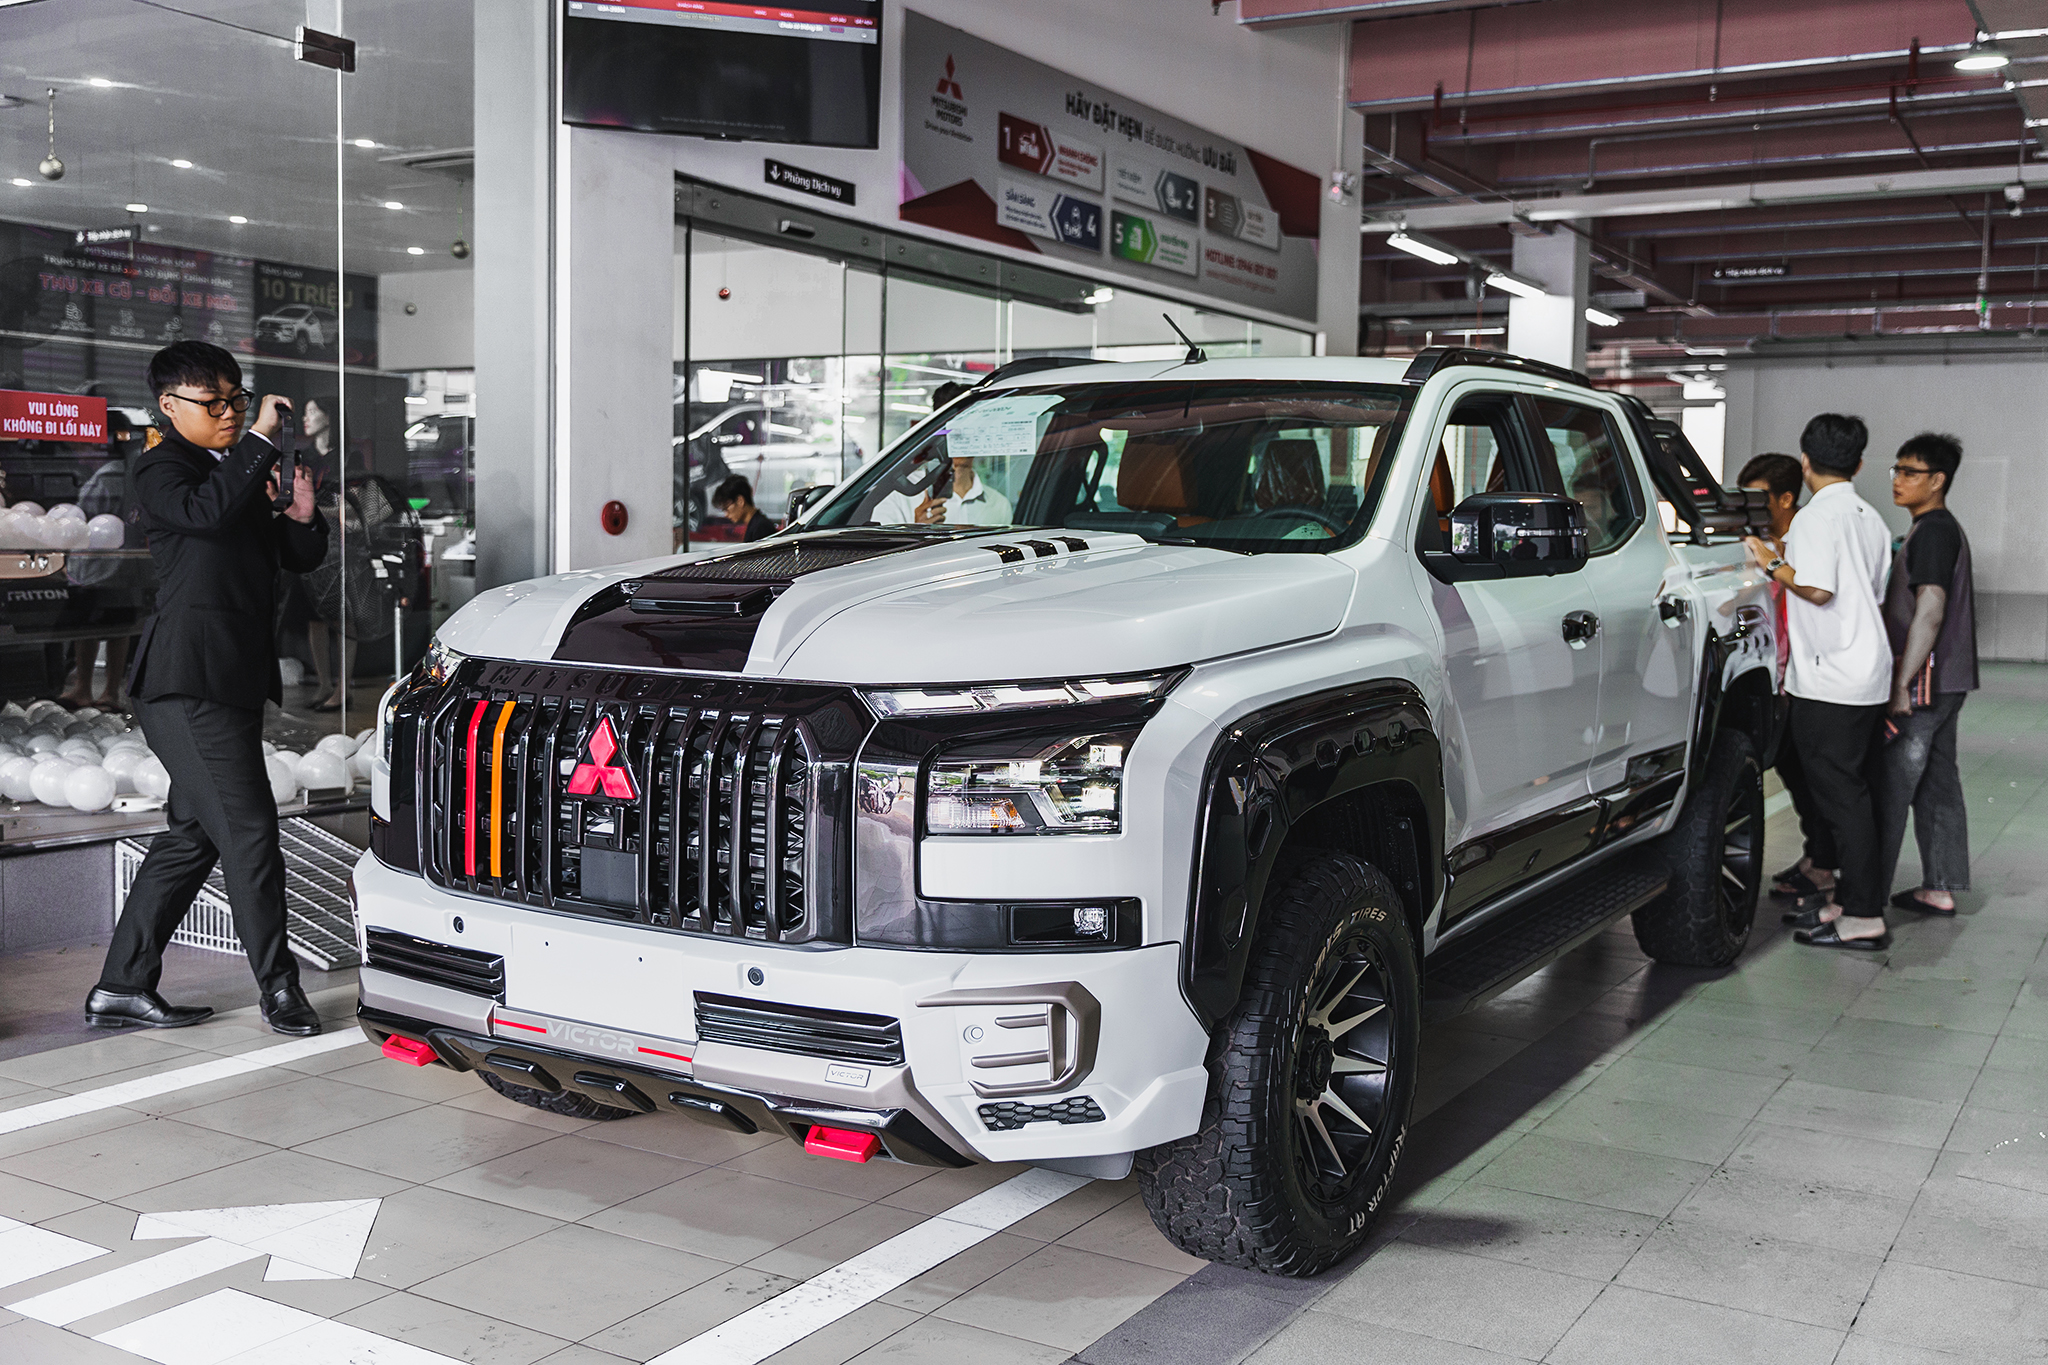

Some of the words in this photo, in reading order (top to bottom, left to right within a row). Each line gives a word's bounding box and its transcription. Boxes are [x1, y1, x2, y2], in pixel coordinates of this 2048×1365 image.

[1092, 102, 1117, 133] ĐẶT
[1117, 113, 1143, 142] HẸN
[1003, 126, 1011, 150] 1
[783, 170, 811, 190] Phòng
[811, 178, 830, 193] Dịch
[831, 185, 842, 198] vụ
[1186, 190, 1195, 210] 2
[1208, 197, 1216, 218] 3
[1087, 213, 1097, 237] 4
[1115, 222, 1124, 245] 5
[40, 273, 77, 293] THU
[82, 279, 104, 297] XE
[108, 280, 132, 300] CŨ
[182, 291, 203, 309] XE
[261, 278, 286, 301] 10
[28, 401, 47, 416] VUI
[50, 400, 79, 418] LÒNG
[3, 417, 43, 434] KHÔNG
[45, 421, 57, 435] ĐI
[60, 418, 77, 436] LỐI
[80, 421, 102, 438] NÀY
[7, 589, 70, 601] TRITON
[489, 665, 782, 706] MITSUBISHI
[1350, 907, 1387, 925] TIRES
[546, 1020, 635, 1056] VICTOR
[831, 1070, 864, 1080] VICTOR
[1367, 1123, 1407, 1212] RAPTOR
[1345, 1211, 1366, 1237] AT
